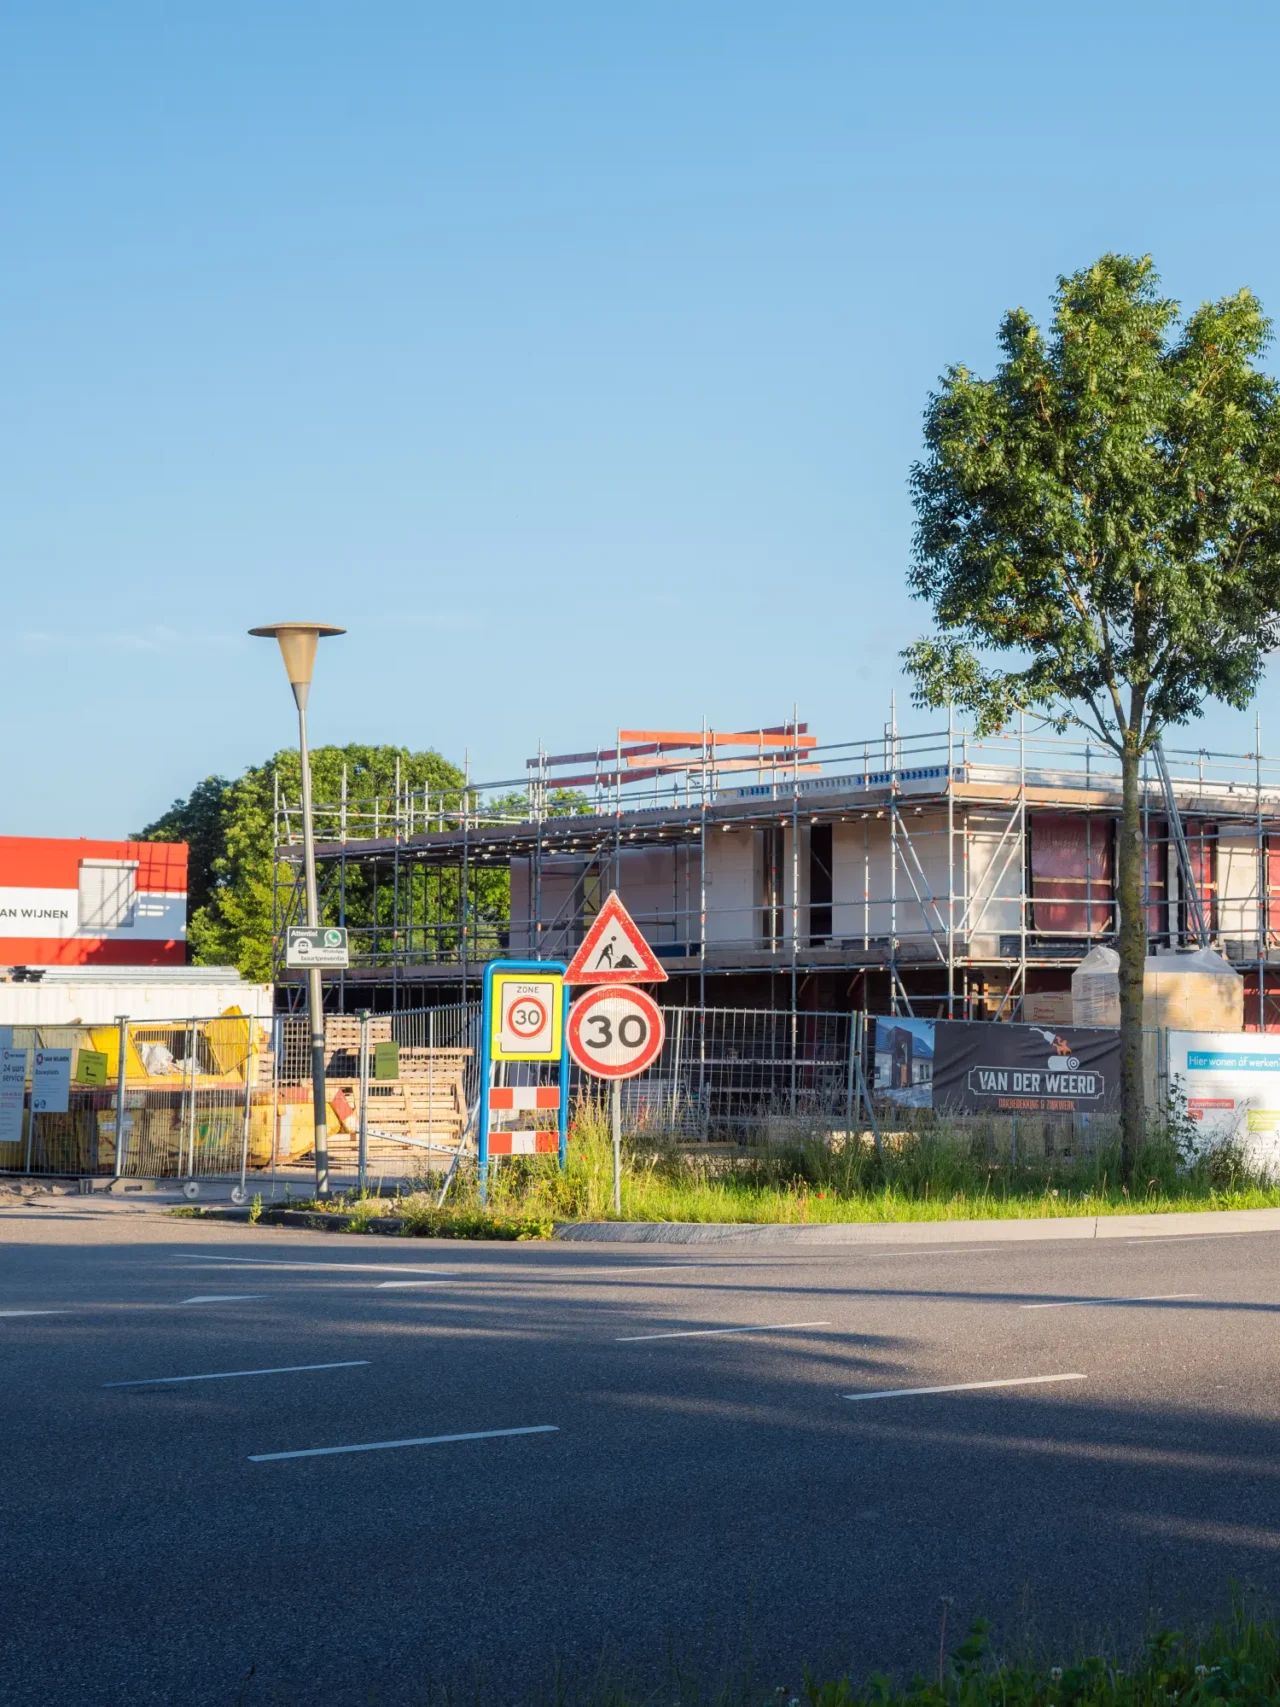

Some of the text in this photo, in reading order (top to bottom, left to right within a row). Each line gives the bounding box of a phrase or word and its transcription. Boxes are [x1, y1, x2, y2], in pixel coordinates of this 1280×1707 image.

[20, 909, 69, 919] WIJNEN
[516, 985, 540, 994] ZONE
[515, 1009, 540, 1026] 30
[585, 1014, 647, 1049] 30
[1189, 1055, 1207, 1066] Hier
[1209, 1059, 1237, 1067] wonen
[3, 1064, 25, 1073] 24 uurs
[2, 1073, 24, 1082] service
[978, 1071, 1096, 1094] VAN DER WEERD
